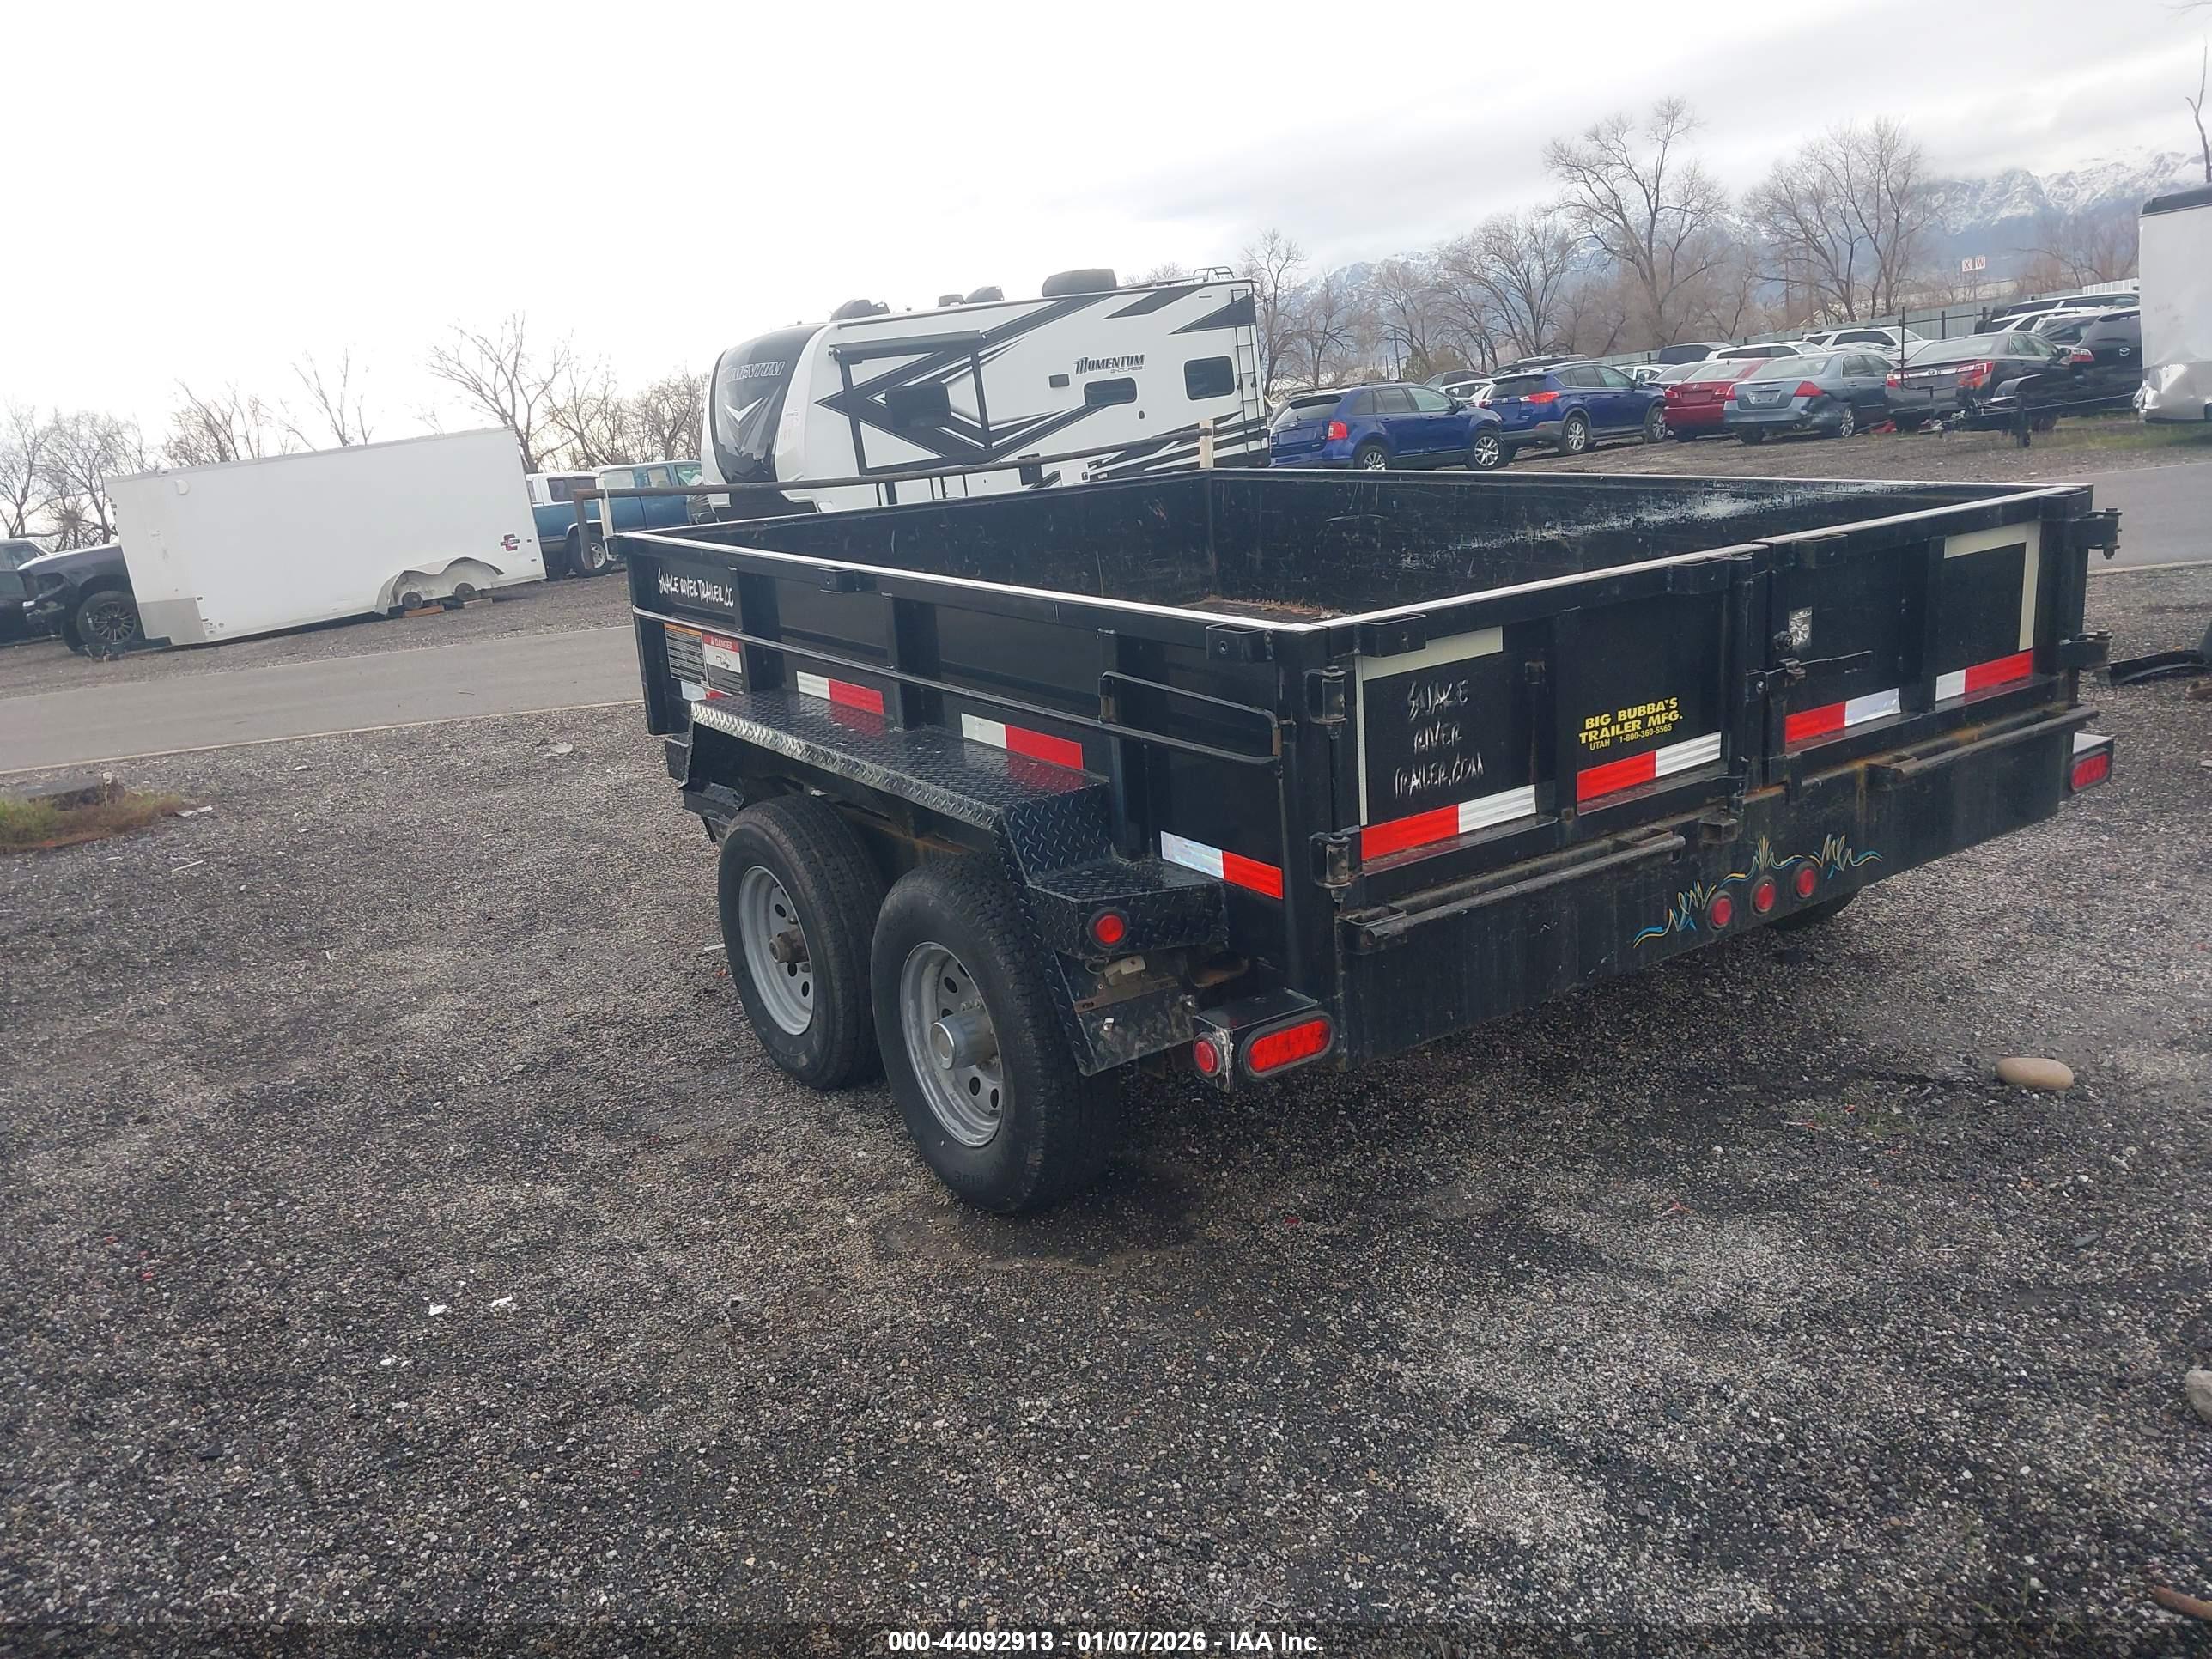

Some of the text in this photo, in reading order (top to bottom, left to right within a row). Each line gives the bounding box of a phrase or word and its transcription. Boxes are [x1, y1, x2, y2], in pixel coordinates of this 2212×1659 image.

[1073, 354, 1145, 375] MOMENTUM
[1579, 710, 1683, 744] TRAILER MFG.
[1585, 697, 1678, 730] BIG BUBBA'S
[1413, 720, 1462, 754] RIVER
[1589, 739, 1611, 750] UTAH
